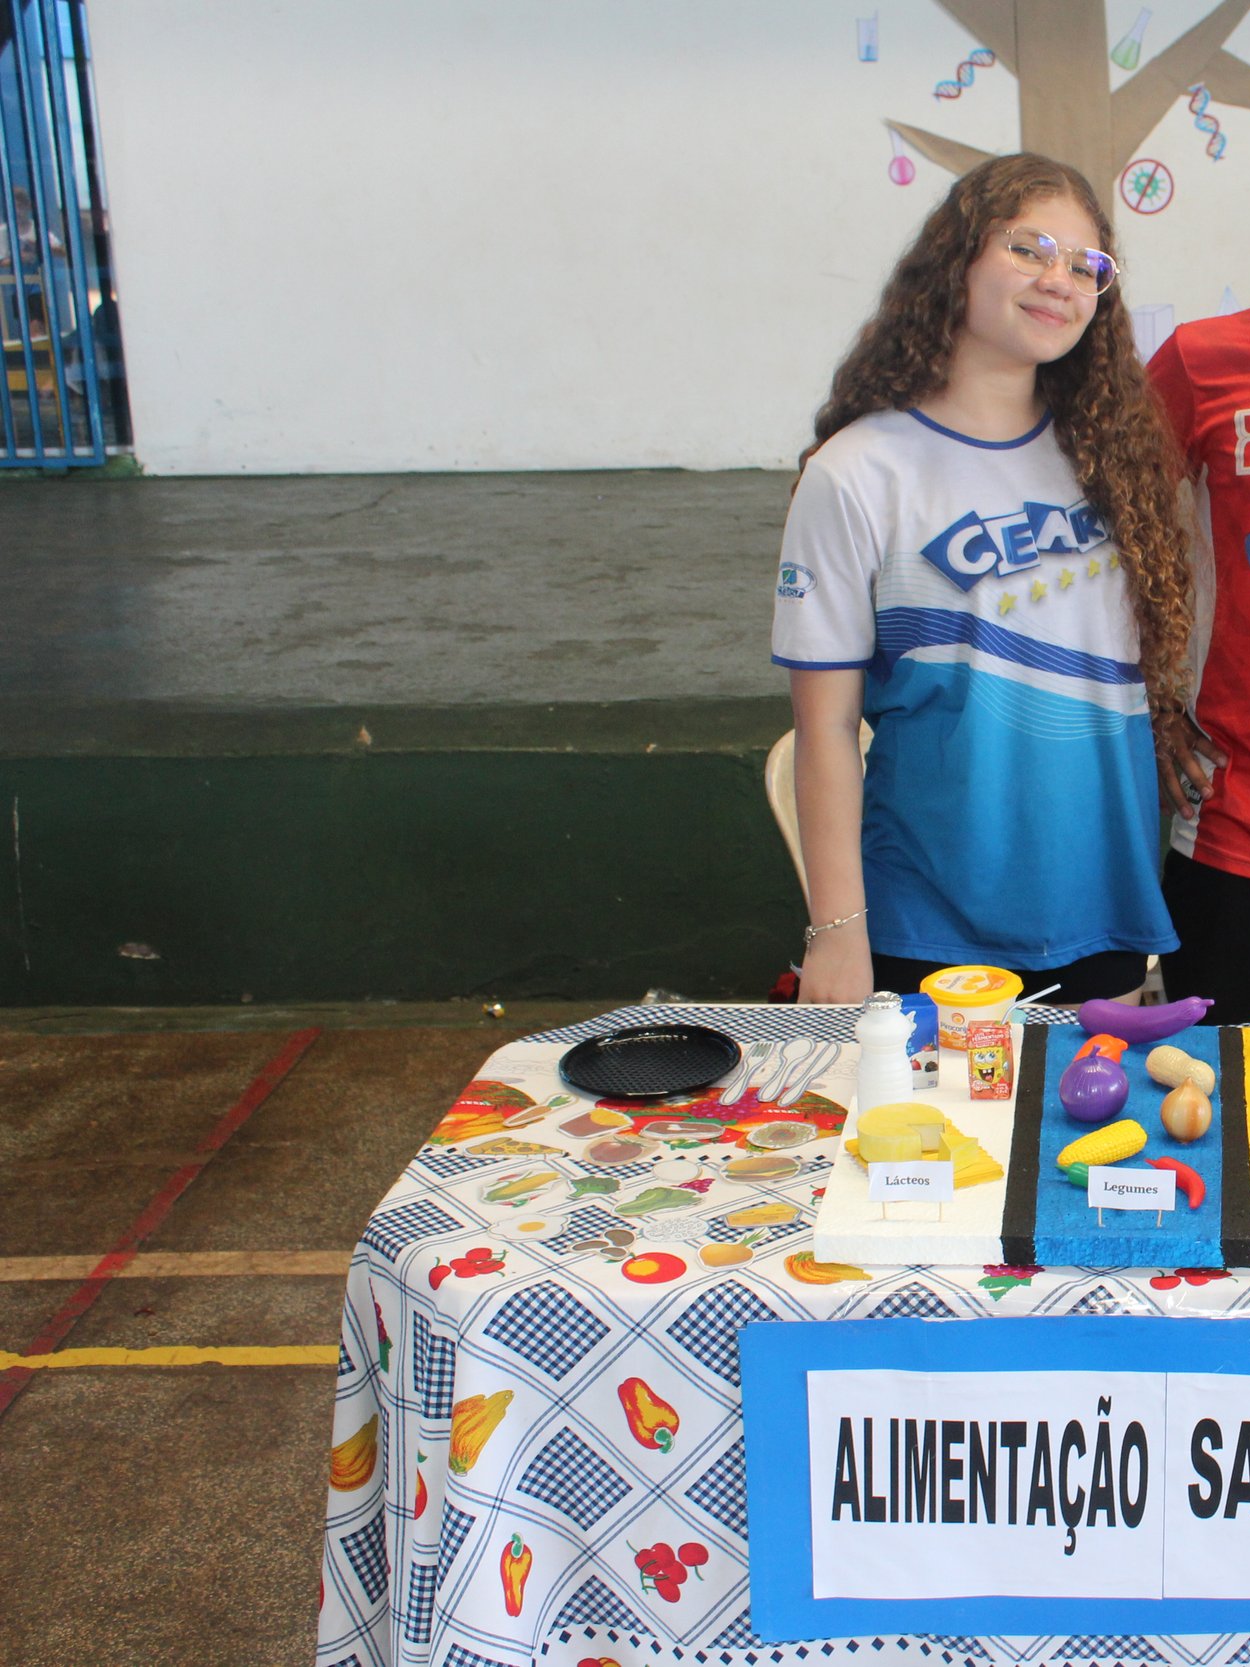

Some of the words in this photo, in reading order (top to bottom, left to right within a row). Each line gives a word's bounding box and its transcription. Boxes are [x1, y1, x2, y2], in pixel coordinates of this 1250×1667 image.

[946, 505, 1105, 575] CEAR
[885, 1175, 930, 1186] Lácteos
[1104, 1181, 1158, 1195] Legumes
[831, 1395, 1149, 1556] ALIMENTAÇÃO
